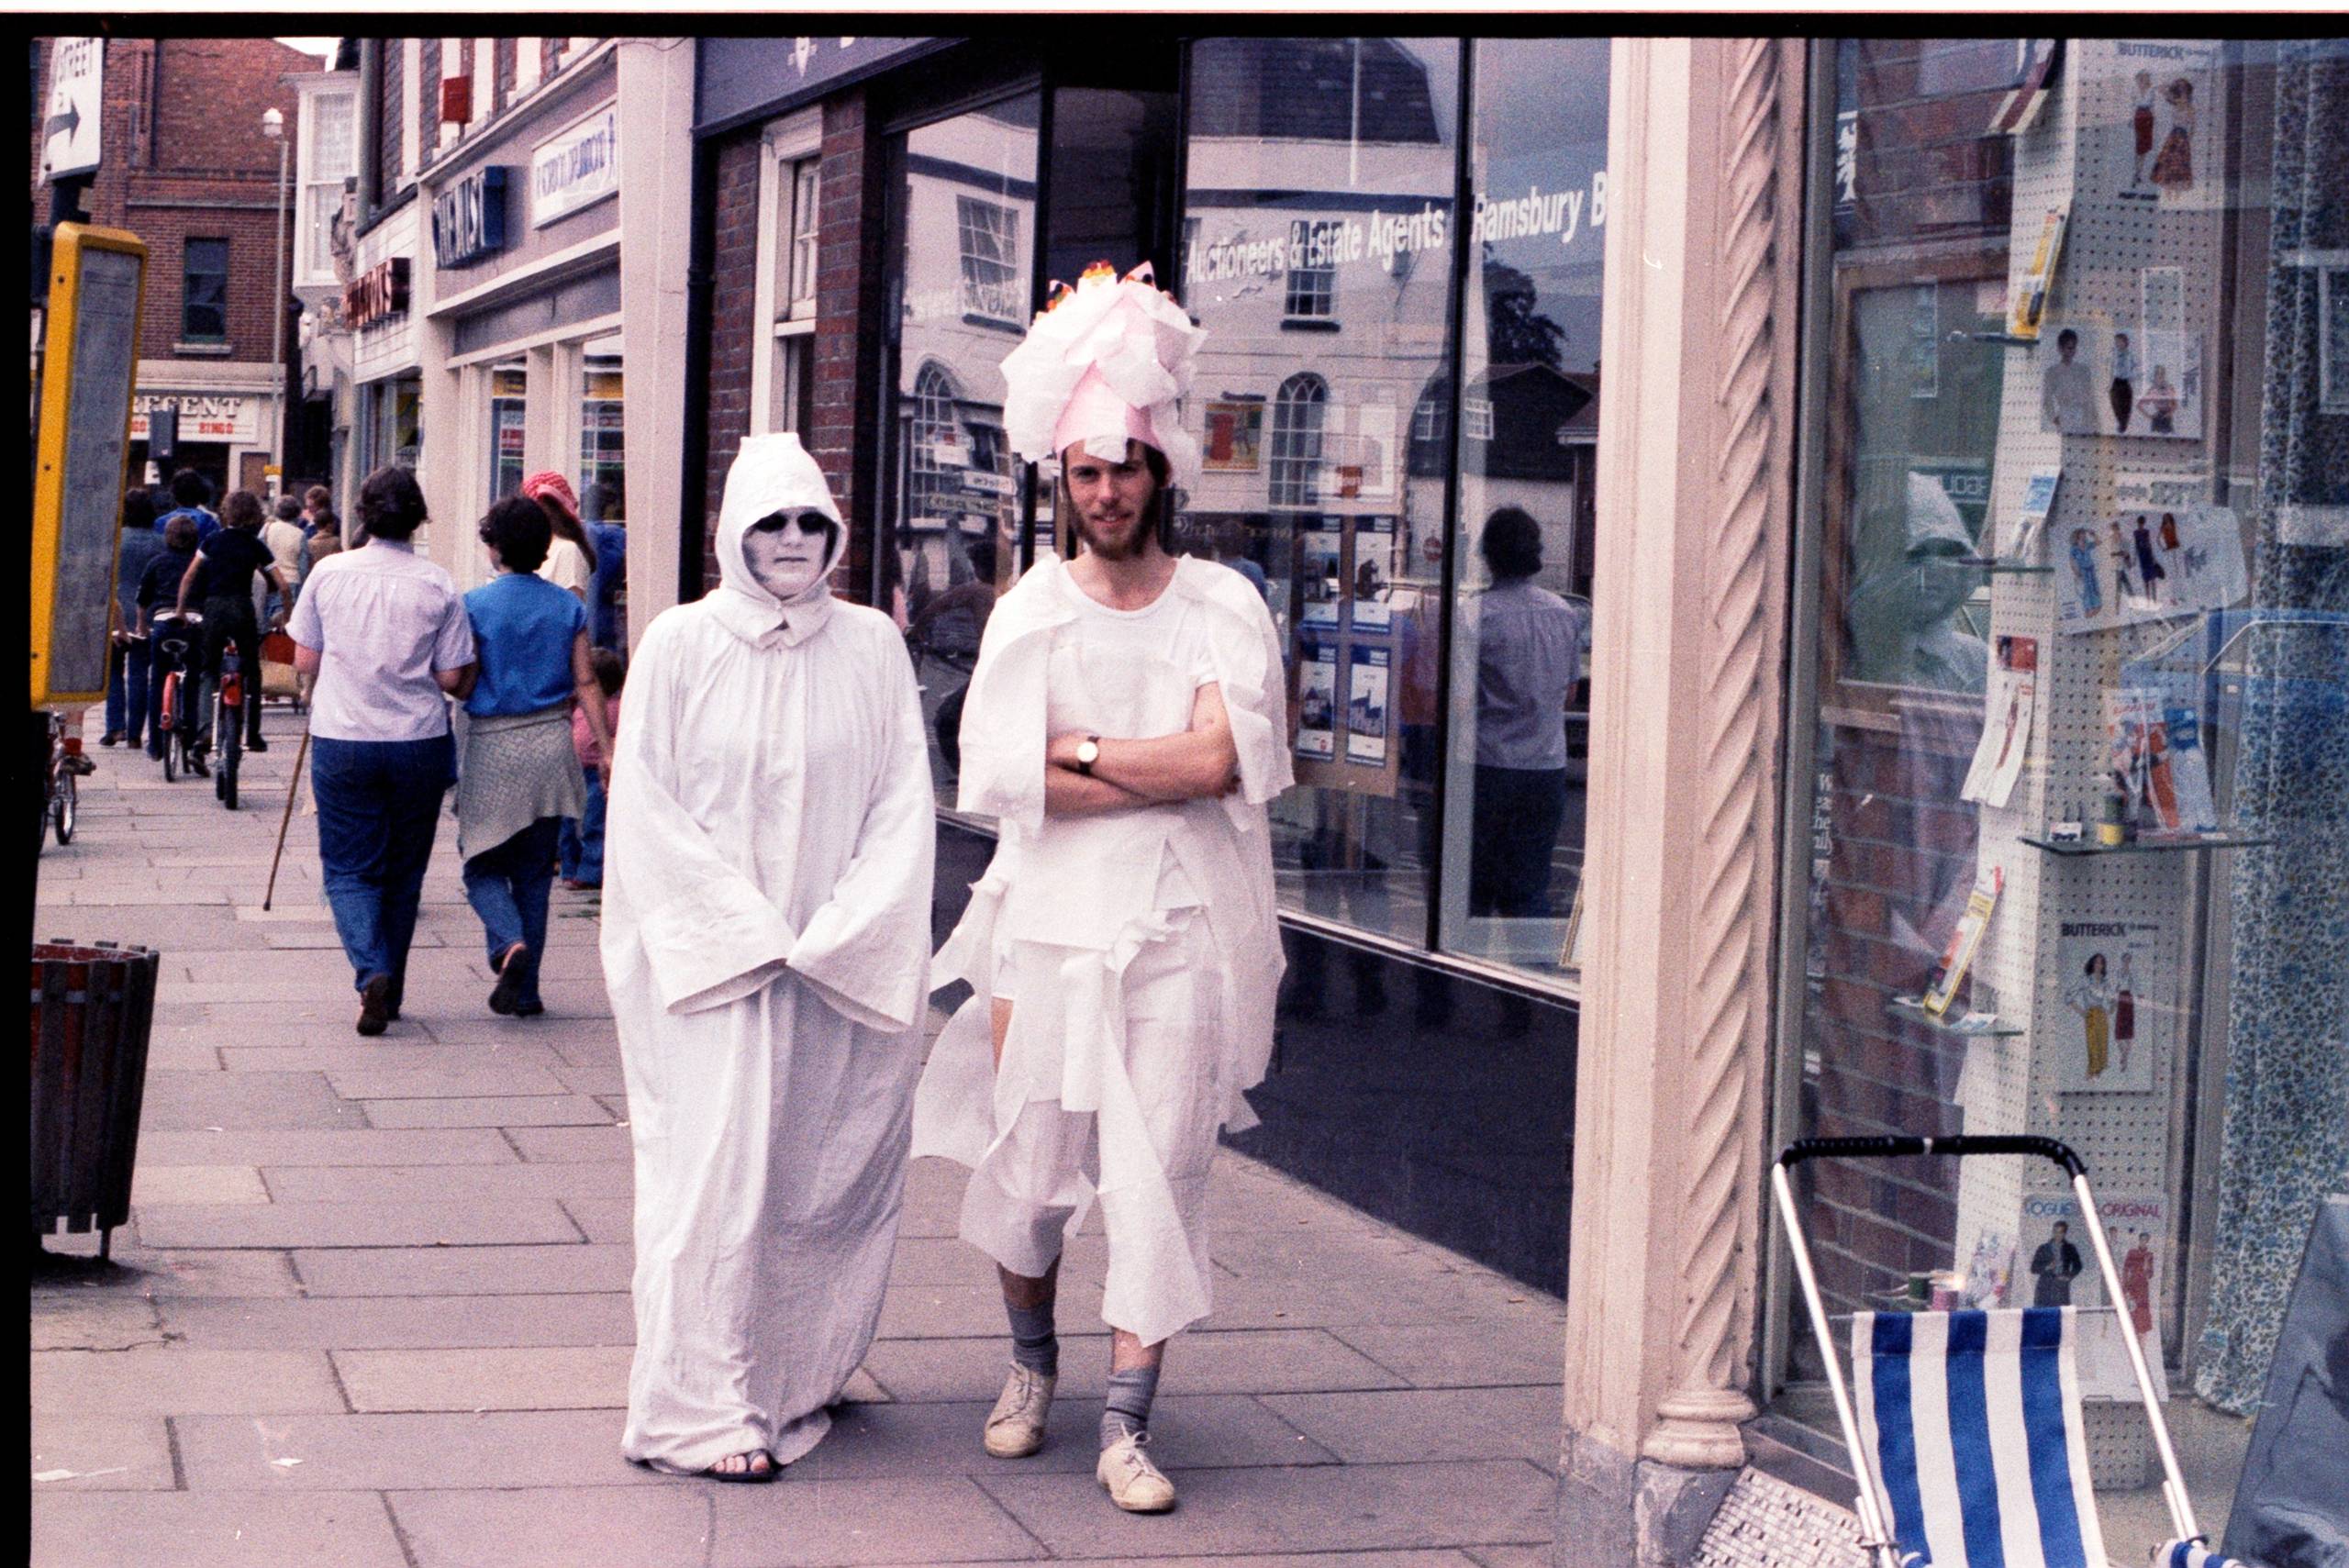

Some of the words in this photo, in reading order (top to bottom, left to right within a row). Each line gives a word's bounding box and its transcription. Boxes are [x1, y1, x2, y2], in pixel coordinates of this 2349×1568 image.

[1471, 185, 1584, 244] Ramsbury
[1186, 236, 1285, 284] Auctioneers
[1289, 221, 1302, 269] &
[1308, 218, 1362, 266] Estate
[1367, 202, 1444, 272] Agents
[2061, 922, 2126, 937] BUTTERICK
[2102, 1202, 2160, 1218] ORIGINAL
